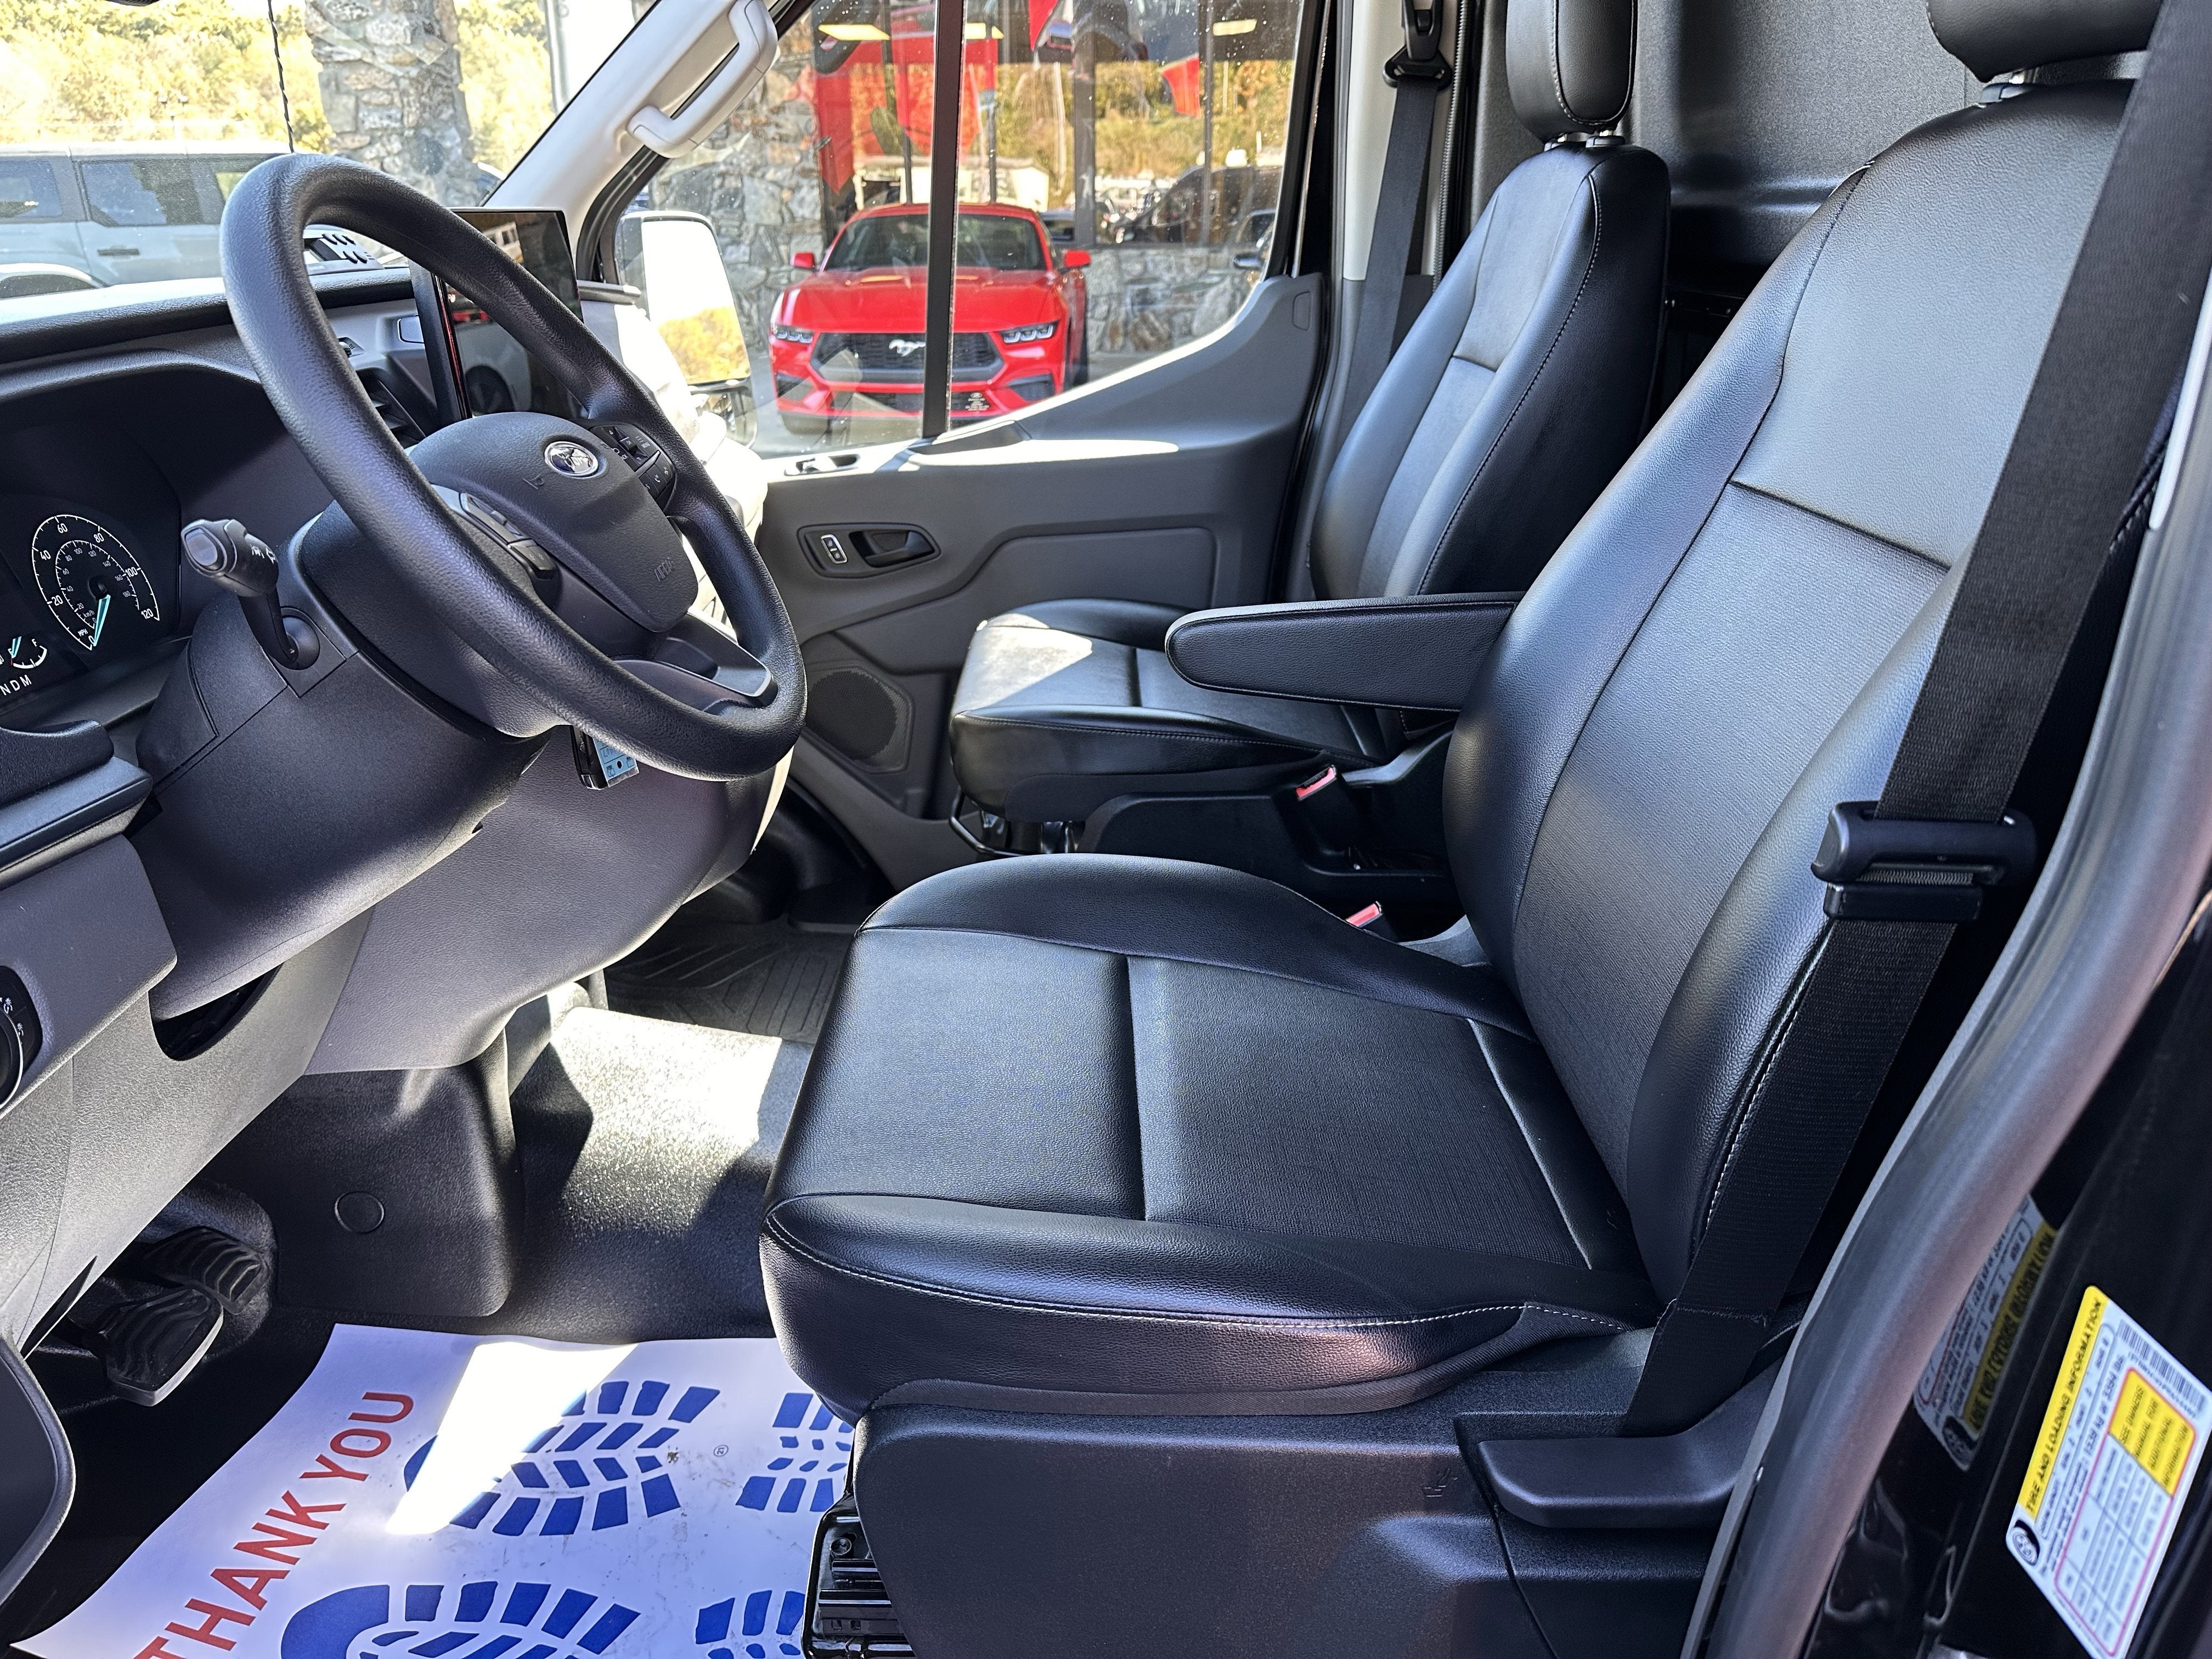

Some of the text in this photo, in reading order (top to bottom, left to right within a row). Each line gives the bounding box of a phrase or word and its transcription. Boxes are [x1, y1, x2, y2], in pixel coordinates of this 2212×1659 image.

[57, 523, 68, 534] 60
[93, 533, 105, 543] 80
[40, 550, 51, 560] 40
[125, 567, 138, 578] 100
[51, 595, 64, 606] 20
[83, 610, 95, 618] km/h
[141, 608, 154, 619] 120
[77, 628, 88, 636] MPH
[31, 639, 37, 647] F
[88, 635, 95, 645] 0
[10, 680, 20, 691] D
[20, 674, 32, 687] M
[2026, 1480, 2040, 1512] TIRE
[2036, 1453, 2050, 1482] AND
[2045, 1393, 2070, 1453] LOADING
[2066, 1300, 2102, 1393] INFORMATION
[2092, 1413, 2104, 1432] kg
[133, 1392, 414, 1659] THANK YOU
